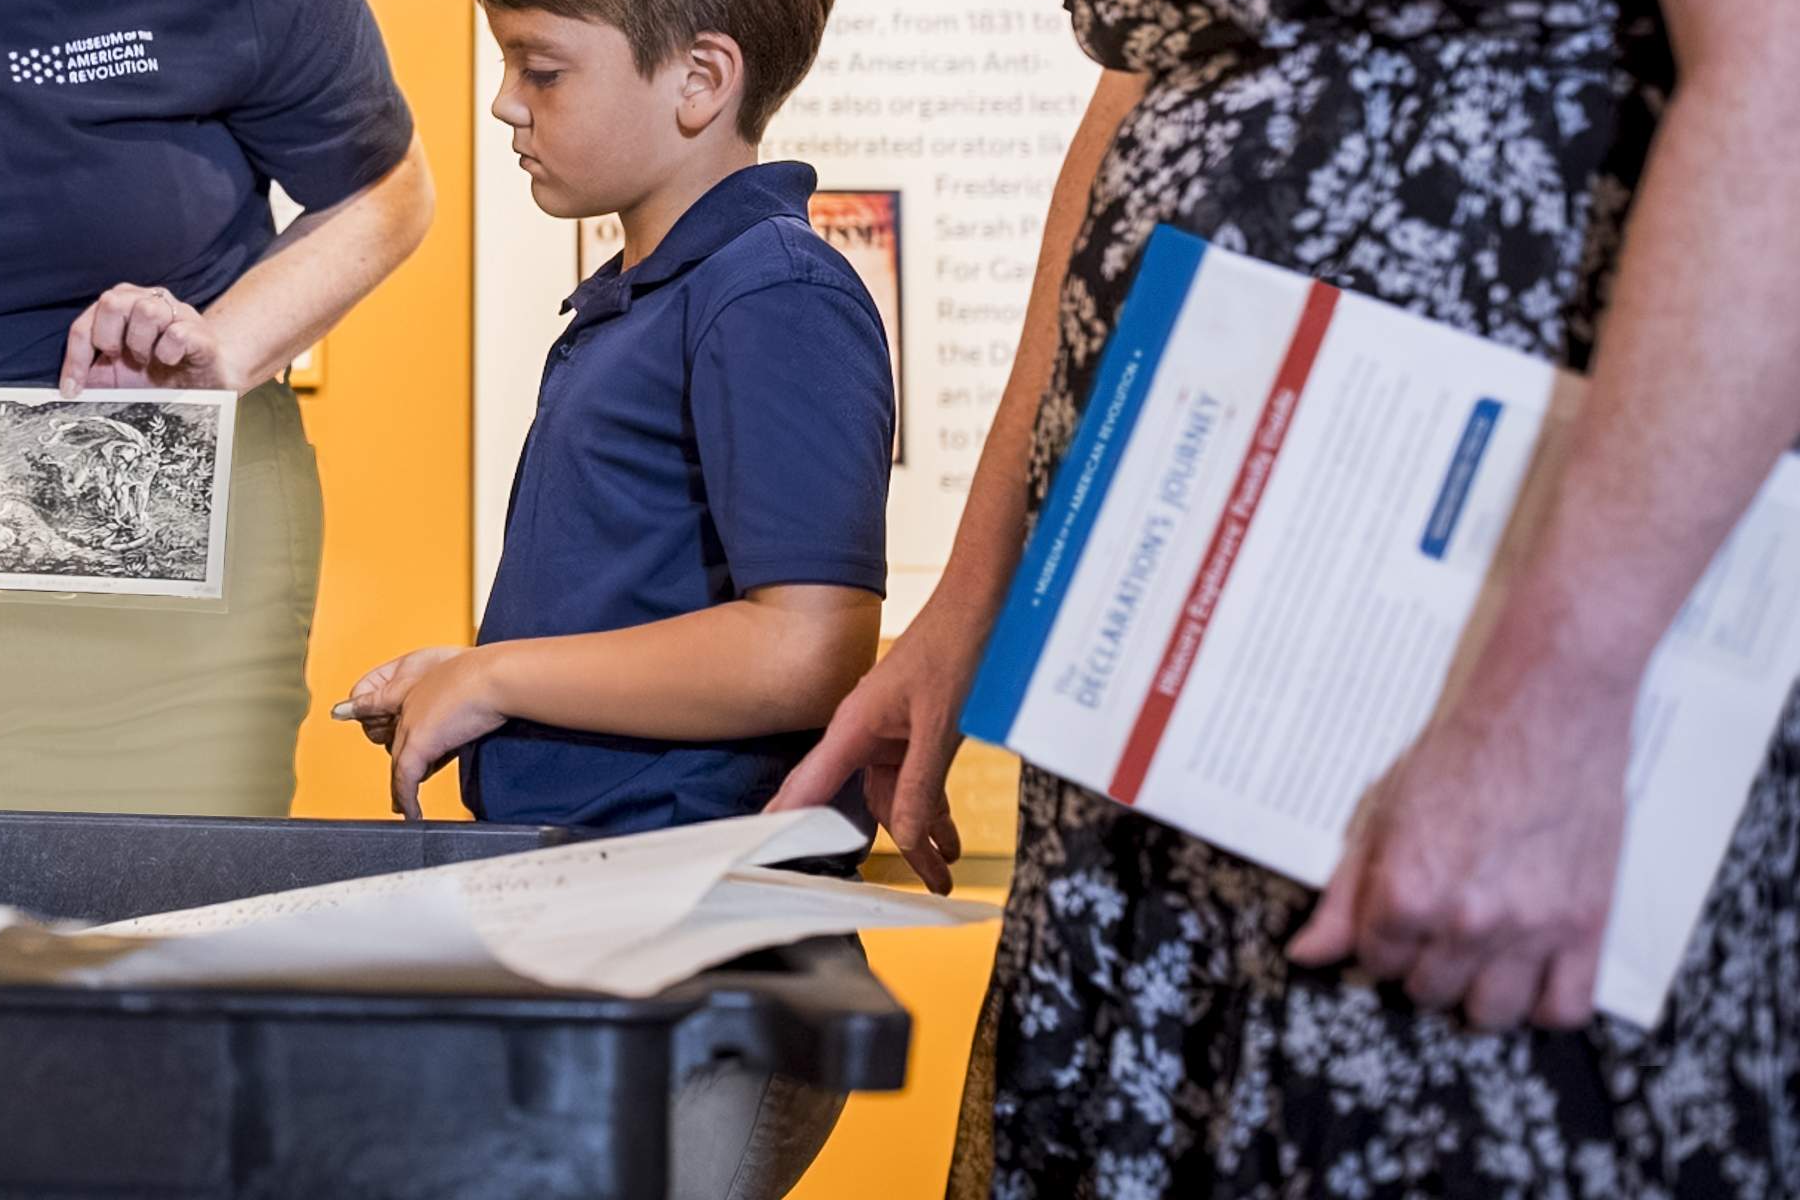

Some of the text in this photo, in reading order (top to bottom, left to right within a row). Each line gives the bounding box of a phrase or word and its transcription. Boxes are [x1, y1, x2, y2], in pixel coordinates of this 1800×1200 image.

[64, 31, 124, 55] MUSEUM
[67, 43, 145, 70] AMERICAN
[69, 58, 159, 84] REVOLUTION
[1028, 94, 1085, 115] lect
[935, 174, 1053, 200] Frederic
[1161, 389, 1222, 512] JOURNEY
[1036, 536, 1067, 597] MUSEUM
[1070, 442, 1107, 511] AMERICAN
[1101, 360, 1139, 442] REVOLUTION
